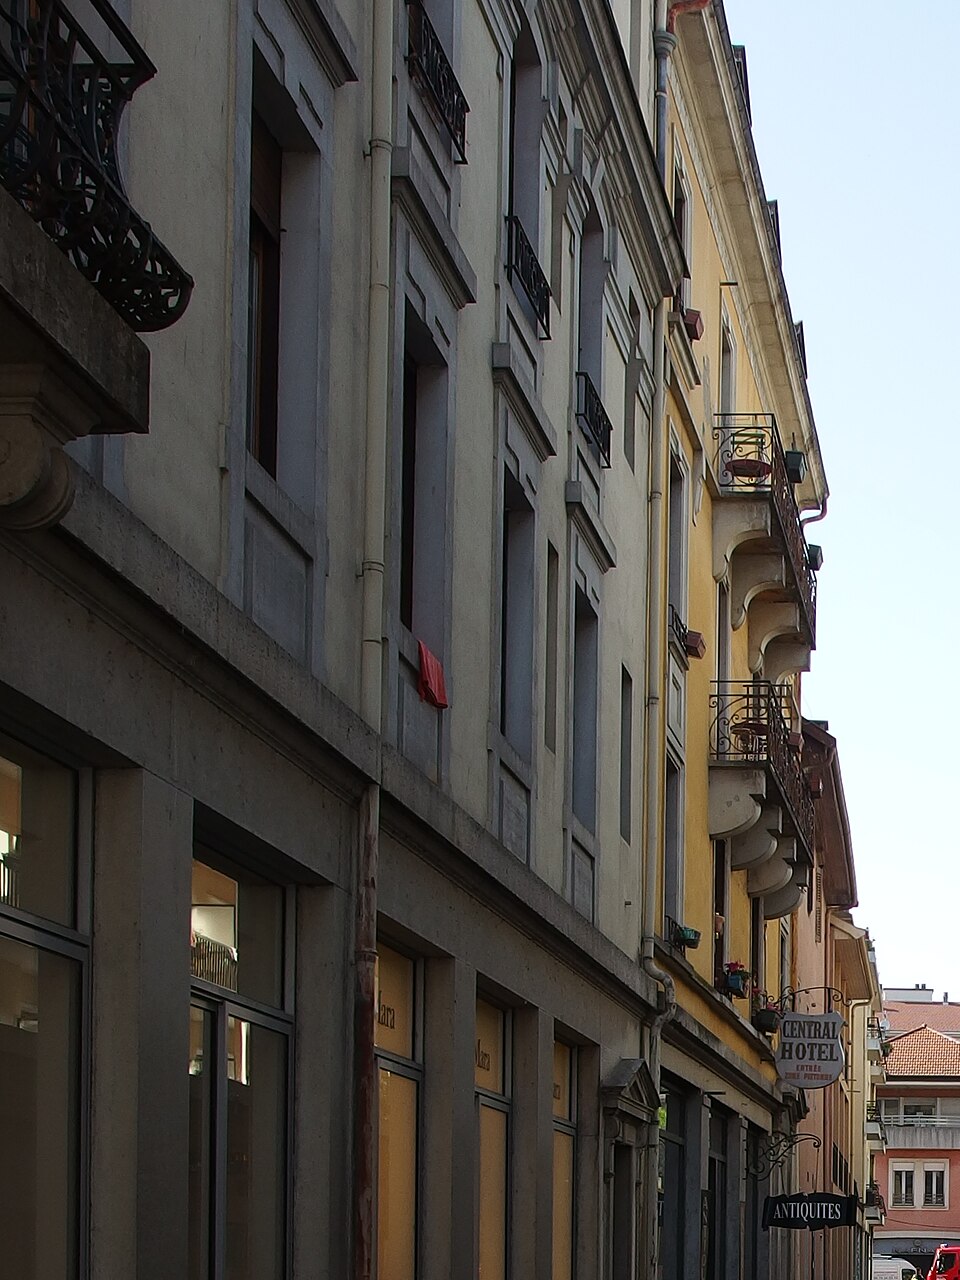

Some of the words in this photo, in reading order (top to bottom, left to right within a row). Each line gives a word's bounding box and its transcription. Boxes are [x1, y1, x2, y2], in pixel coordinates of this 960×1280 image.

[783, 1021, 838, 1039] CENTRAL
[781, 1042, 839, 1061] HOTEL
[774, 1202, 841, 1222] ANTIQUITES
